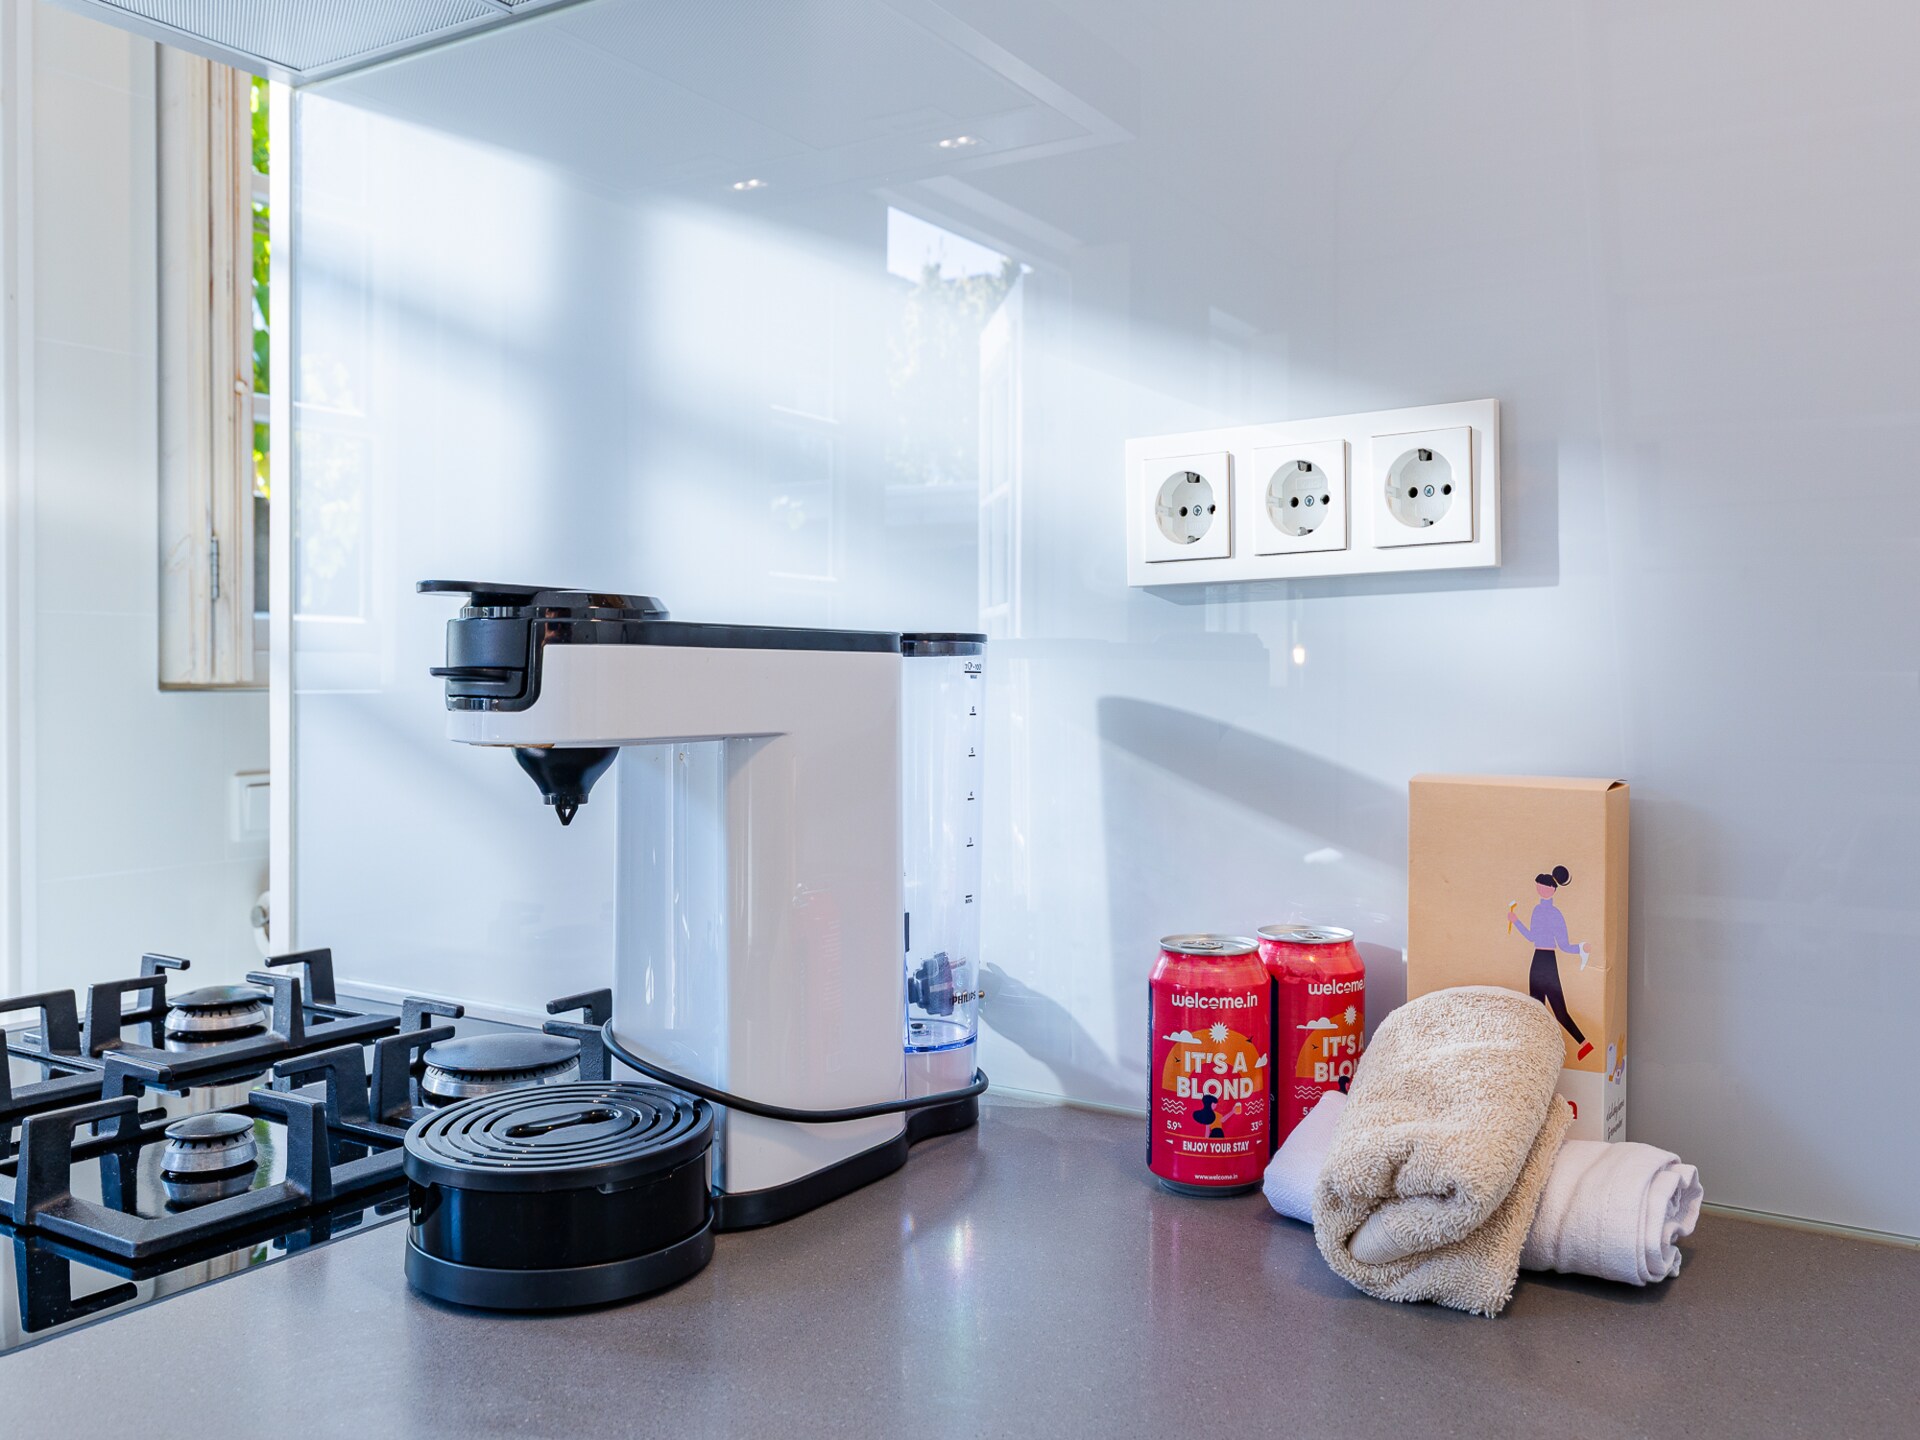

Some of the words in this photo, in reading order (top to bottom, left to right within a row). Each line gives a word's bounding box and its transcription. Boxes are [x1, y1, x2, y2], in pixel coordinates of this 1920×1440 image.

[1171, 991, 1258, 1009] welcome.in
[1322, 1034, 1356, 1057] IT'S
[1184, 1051, 1228, 1074] IT'S
[1232, 1051, 1248, 1074] A
[1176, 1075, 1254, 1100] BLOND
[1183, 1140, 1208, 1153] ENJOY
[1210, 1143, 1231, 1153] YOUR
[1233, 1141, 1250, 1152] STAY
[1194, 1173, 1238, 1181] www.welcome.in
